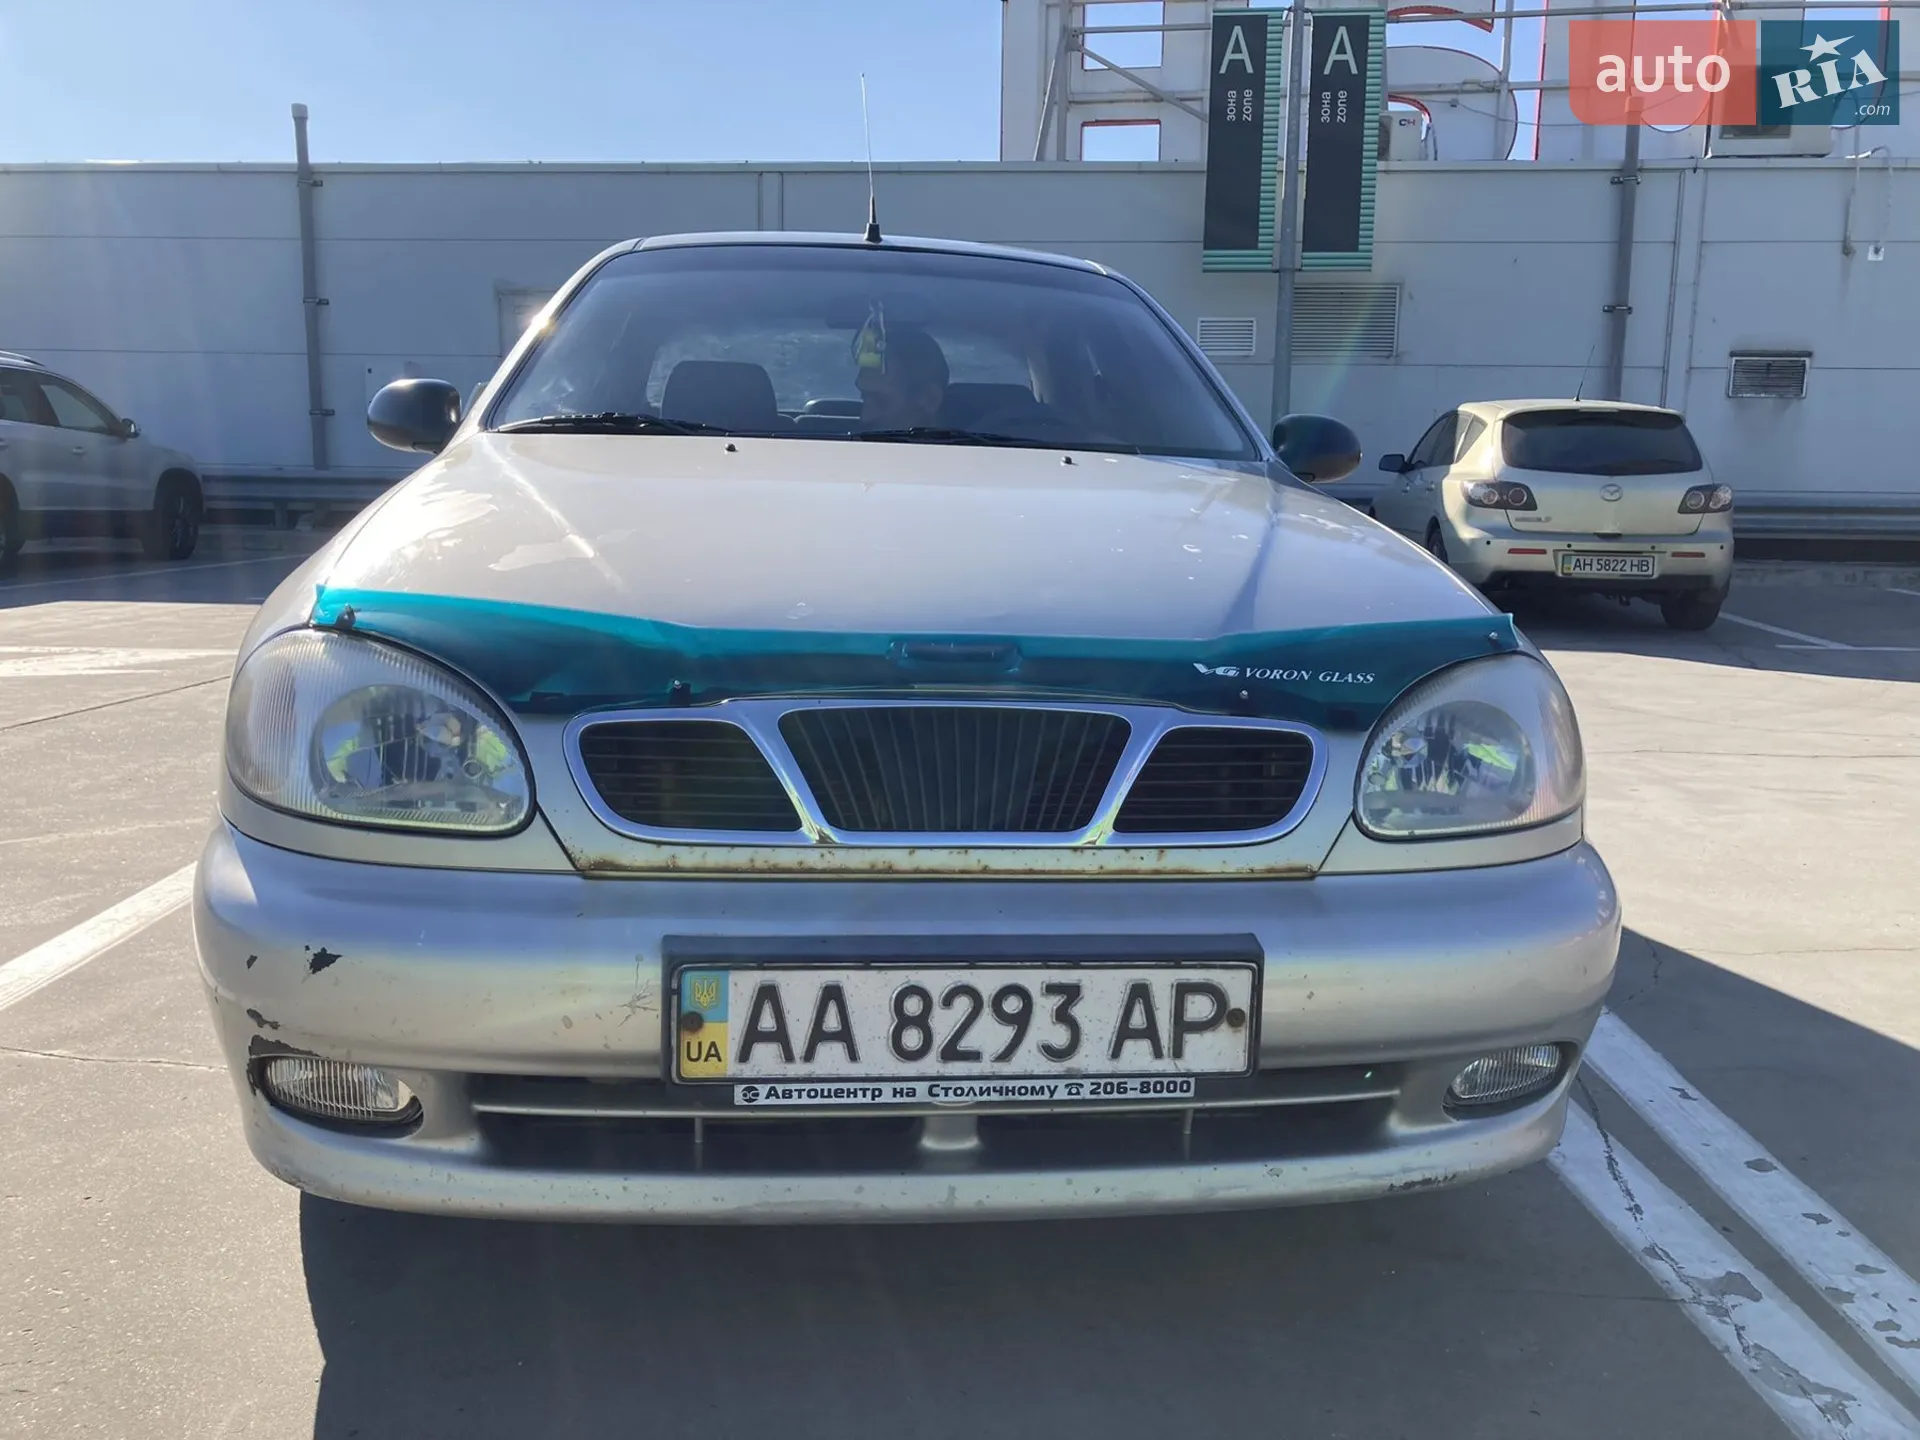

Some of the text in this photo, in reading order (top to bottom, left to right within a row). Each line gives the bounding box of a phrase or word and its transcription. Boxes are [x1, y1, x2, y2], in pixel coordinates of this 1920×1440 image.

[1218, 25, 1254, 74] A
[1323, 26, 1359, 75] A
[1227, 89, 1237, 122] зона
[1242, 88, 1253, 122] zone
[1321, 90, 1331, 124] зона
[1336, 89, 1348, 124] zone
[1572, 558, 1594, 572] AH
[1596, 559, 1627, 572] 5822
[1629, 559, 1650, 573] HB
[1245, 667, 1312, 681] VORON
[1318, 670, 1376, 684] GLASS
[737, 979, 1232, 1064] AA 8293 AP
[686, 1042, 723, 1064] UA
[764, 1080, 1192, 1101] Автоцентр на Столичному 206-8000
